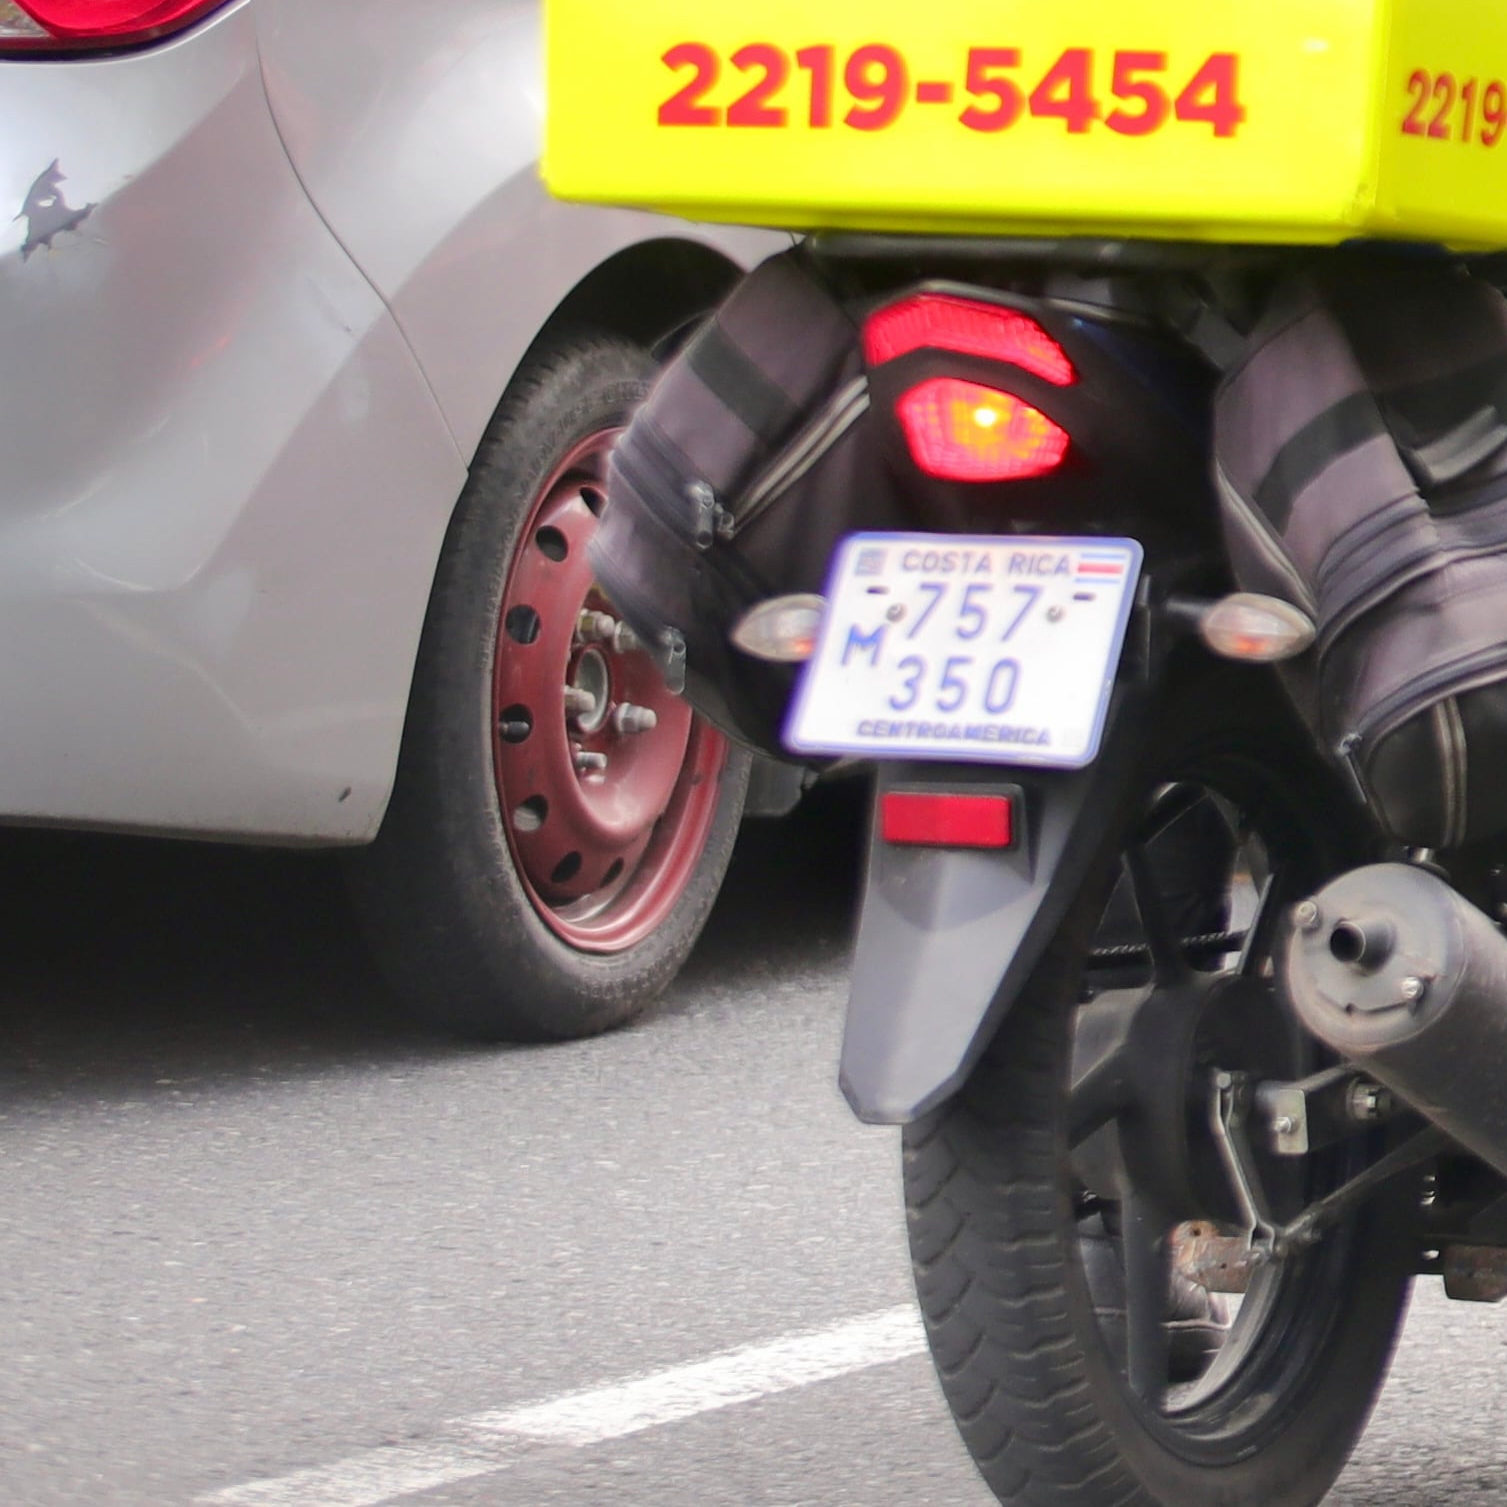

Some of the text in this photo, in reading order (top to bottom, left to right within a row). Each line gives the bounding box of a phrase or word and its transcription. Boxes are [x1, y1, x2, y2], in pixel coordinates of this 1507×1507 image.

[656, 42, 1246, 138] 2219-5454
[901, 548, 1072, 577] COSTA RICA
[906, 581, 1044, 644] 757
[840, 623, 888, 668] M
[888, 655, 1021, 715] 350
[856, 719, 1052, 747] CENTROAMERICA
